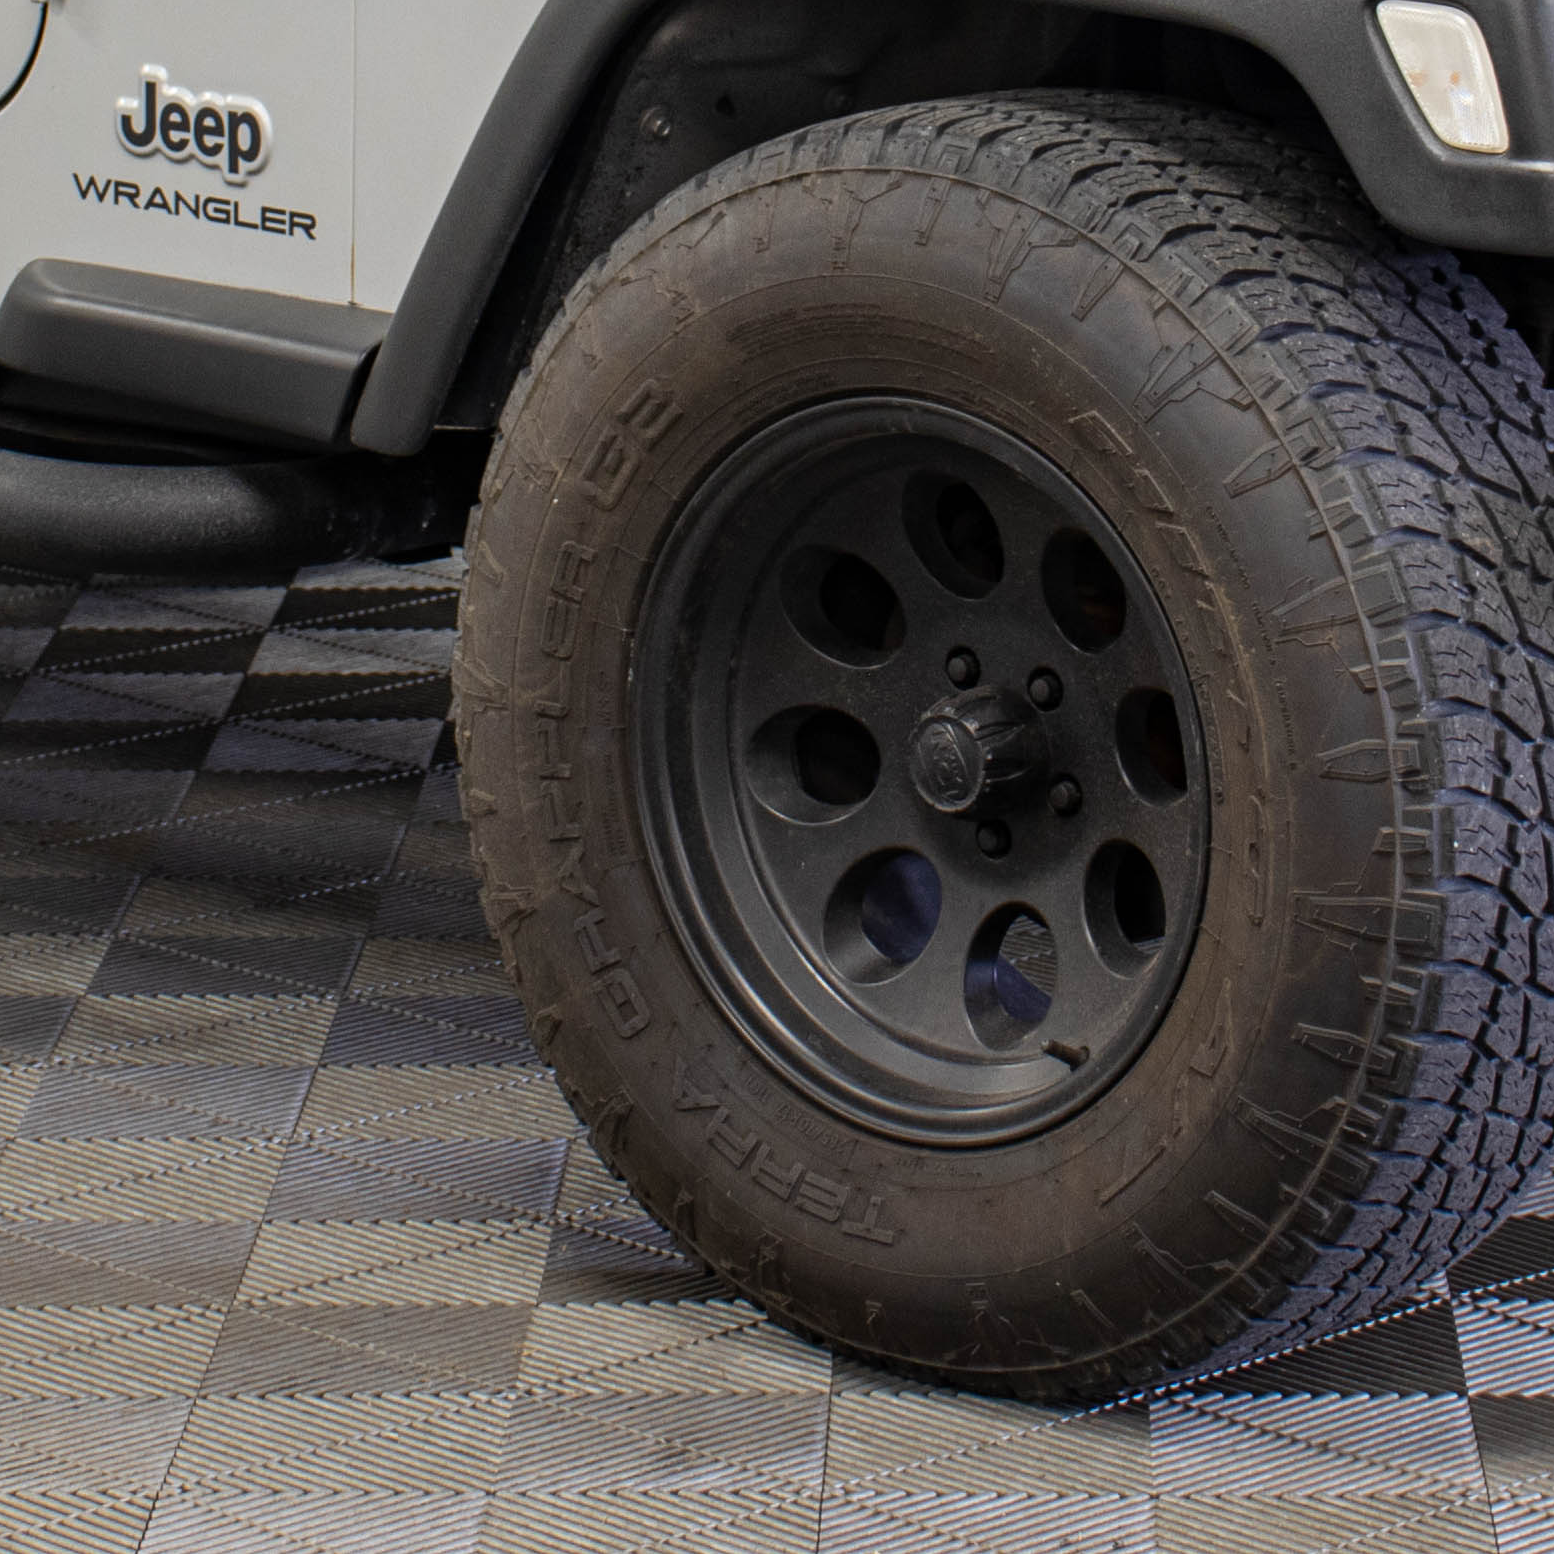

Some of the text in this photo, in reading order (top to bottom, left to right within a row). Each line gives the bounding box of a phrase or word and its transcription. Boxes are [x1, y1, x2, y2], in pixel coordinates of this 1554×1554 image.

[119, 77, 263, 176] Jeep
[73, 173, 317, 240] WRANGLER
[536, 540, 650, 1039] GRAPPLER
[674, 1052, 902, 1246] TERRA
